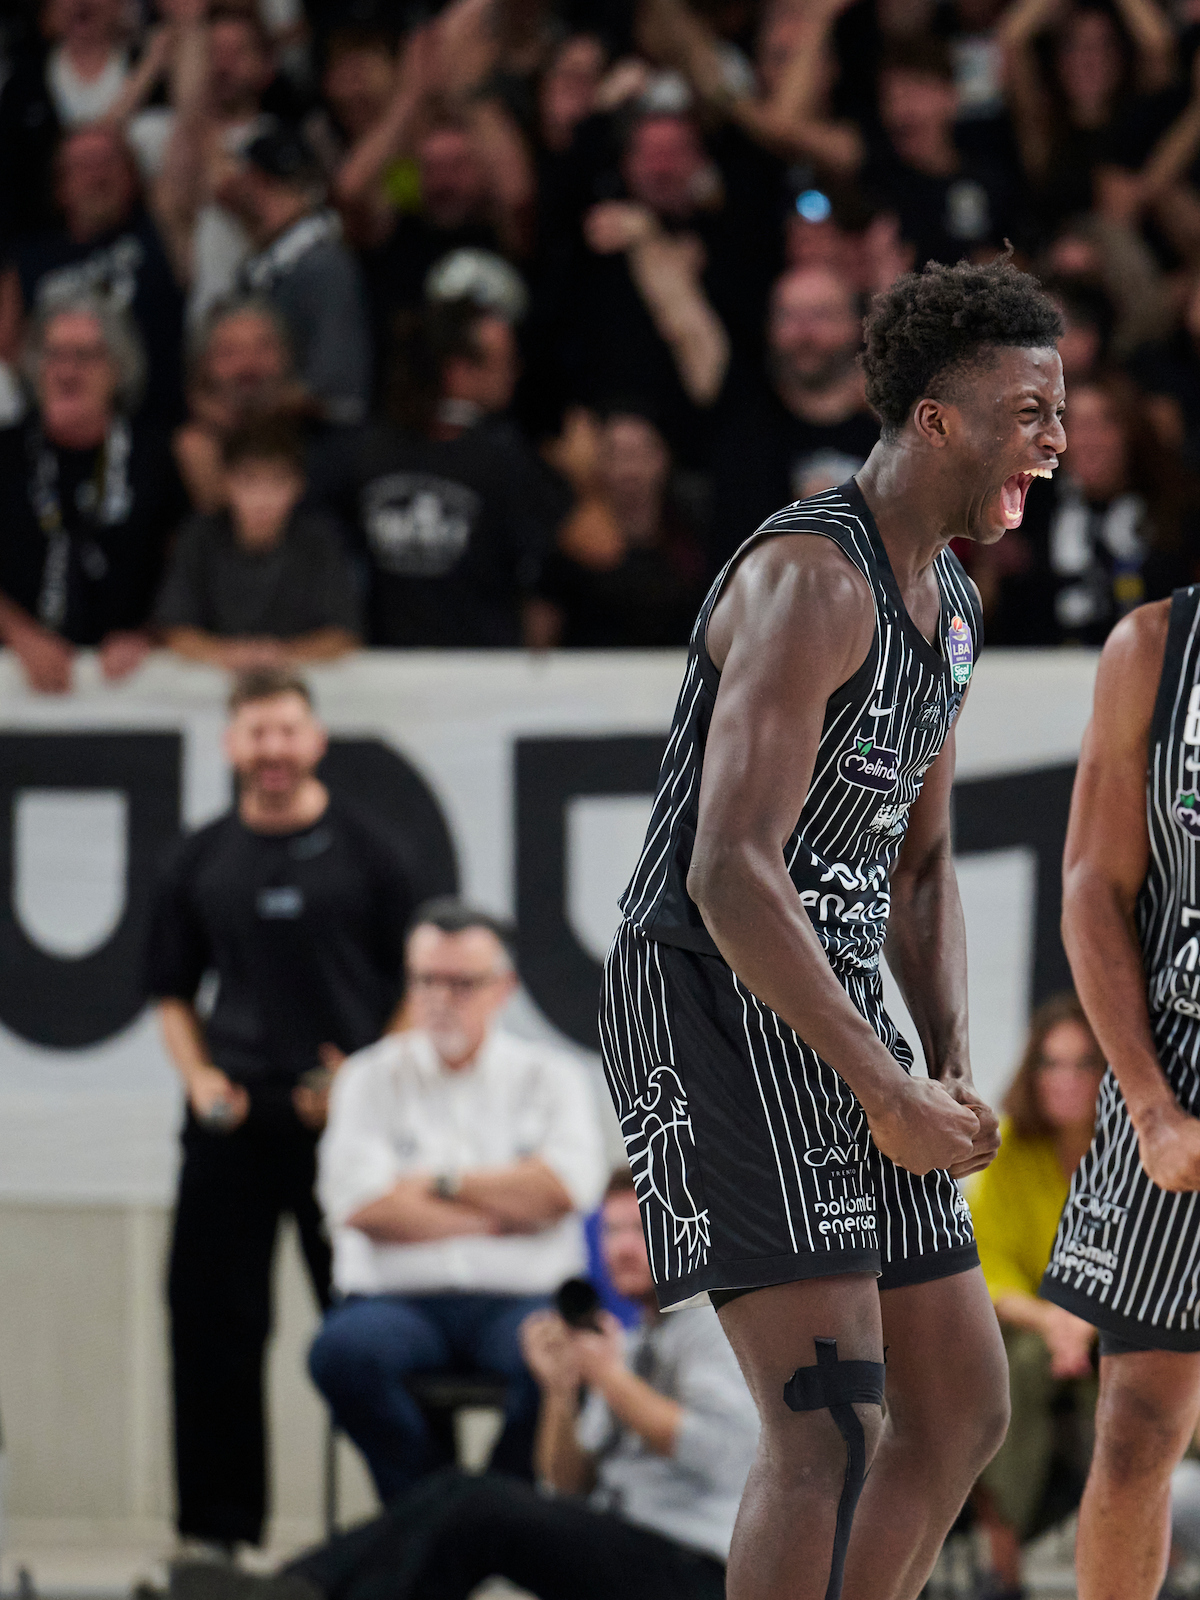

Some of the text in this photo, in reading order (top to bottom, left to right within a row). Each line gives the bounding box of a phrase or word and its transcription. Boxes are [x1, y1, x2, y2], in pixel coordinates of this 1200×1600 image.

[952, 642, 971, 656] LBA
[954, 664, 970, 677] Sisal
[844, 754, 897, 781] Melind
[803, 1143, 861, 1167] CAVI
